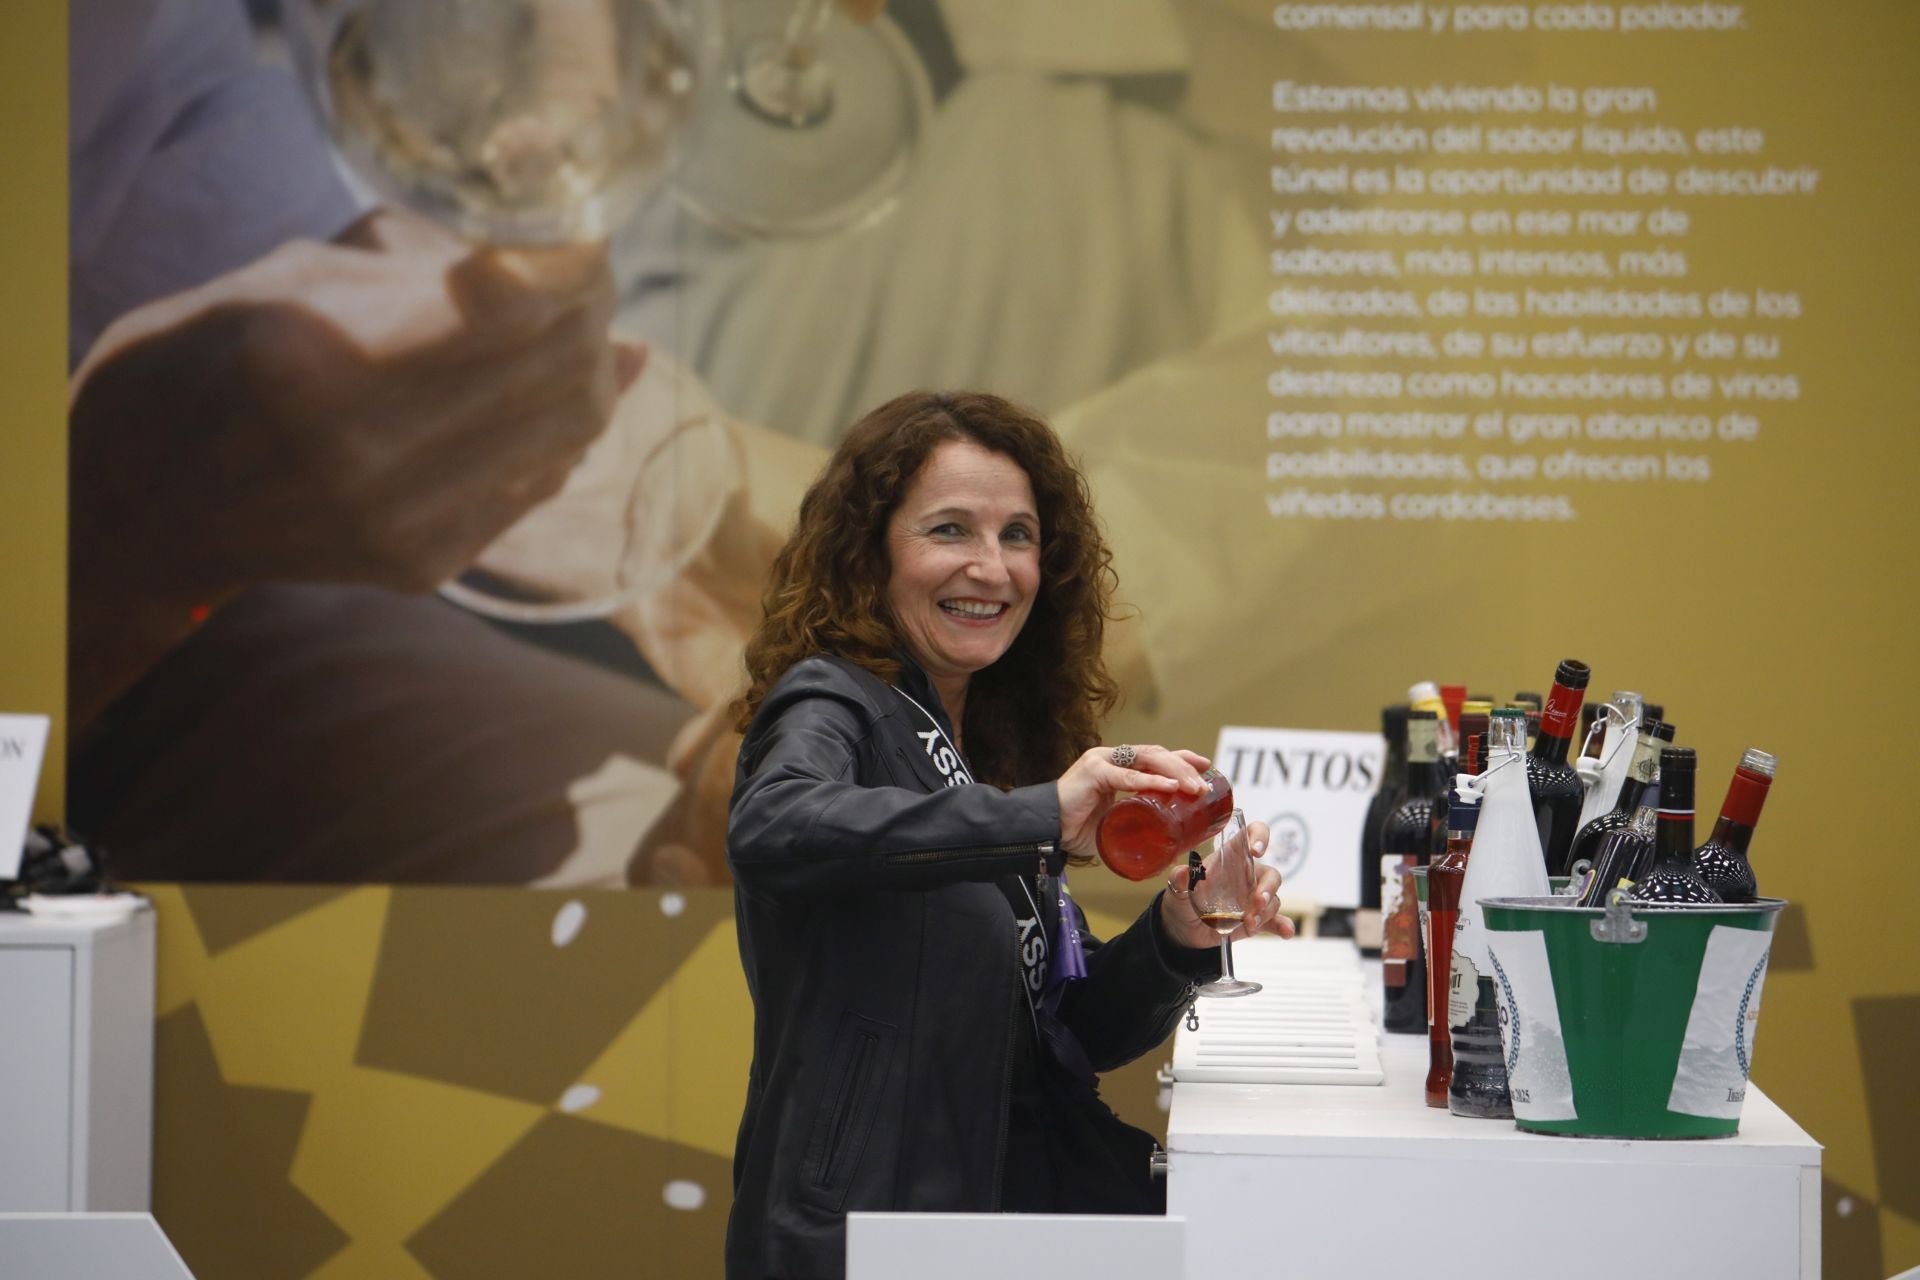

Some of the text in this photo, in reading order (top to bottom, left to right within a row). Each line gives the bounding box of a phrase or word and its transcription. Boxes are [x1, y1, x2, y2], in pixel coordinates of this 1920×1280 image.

[1273, 0, 1424, 31] comensal
[1428, 4, 1450, 35] y
[1453, 4, 1530, 33] para
[1533, 1, 1615, 31] cada
[1272, 79, 1657, 117] Estamos viviendo la gran
[1271, 122, 1428, 154] revolución
[1432, 124, 1482, 154] del
[1486, 124, 1577, 154] sabor
[1694, 126, 1765, 154] este
[1270, 165, 1820, 197] túnel es la oportunidad de descubrir
[1270, 205, 1688, 238] y adentrarse en ese mar de
[1405, 246, 1475, 277] más
[1617, 246, 1689, 277] más
[1426, 287, 1470, 318] de
[1474, 287, 1520, 318] las
[1524, 287, 1703, 318] habilidades
[1707, 288, 1750, 319] de
[1755, 288, 1802, 319] los
[1443, 328, 1485, 358] de
[1491, 332, 1527, 359] su
[1531, 326, 1664, 359] esfuerzo
[1670, 335, 1689, 362] y
[1694, 329, 1737, 359] de
[1743, 334, 1780, 359] su
[1267, 368, 1800, 401] destreza como hacedores de vinos
[1267, 411, 1343, 440] para
[1346, 411, 1469, 439] mostrar
[1473, 409, 1504, 440] el
[1507, 413, 1582, 444] gran
[1716, 410, 1759, 441] de
[1476, 453, 1538, 483] que
[1542, 447, 1661, 481] ofrecen
[1665, 451, 1712, 481] los
[1266, 487, 1386, 520] viñedos
[1226, 743, 1378, 793] TINTOS
